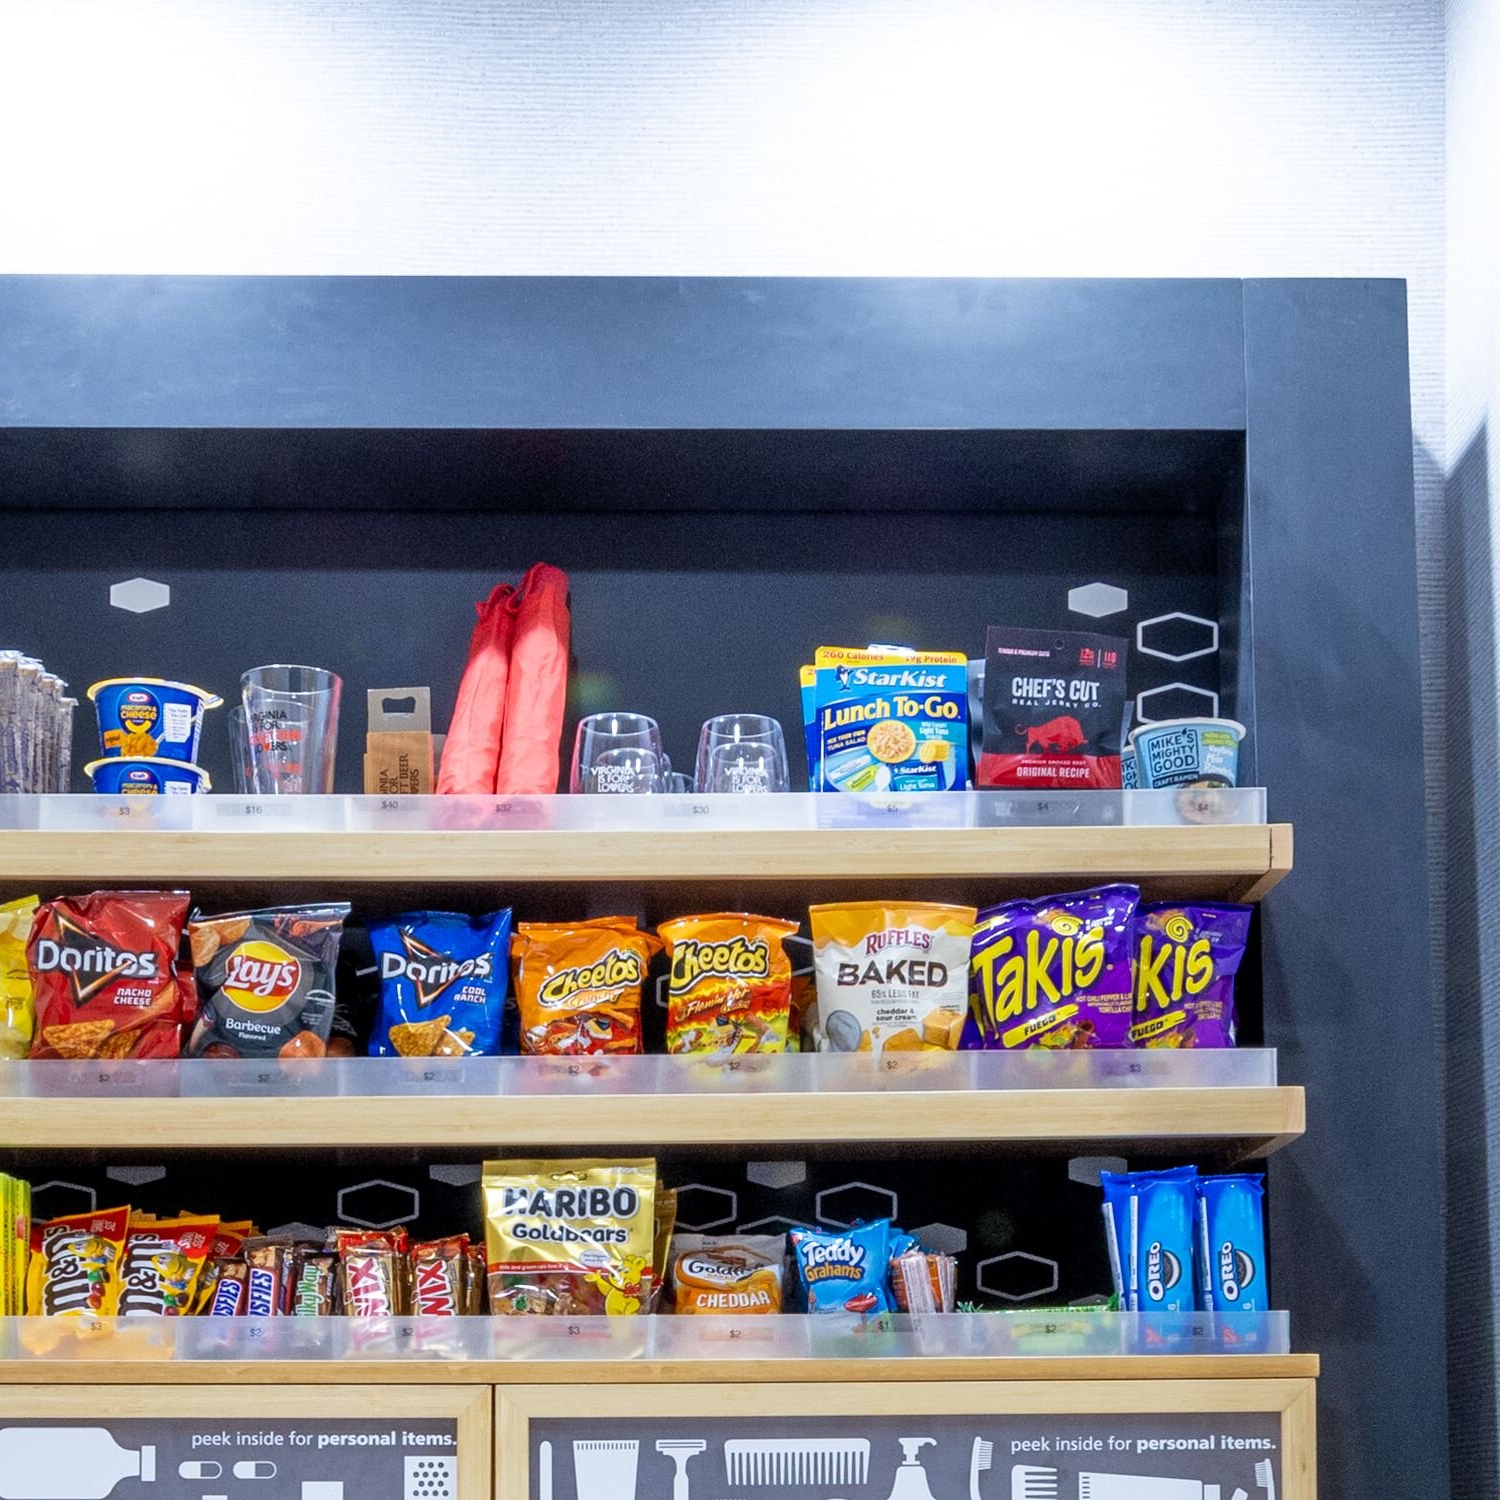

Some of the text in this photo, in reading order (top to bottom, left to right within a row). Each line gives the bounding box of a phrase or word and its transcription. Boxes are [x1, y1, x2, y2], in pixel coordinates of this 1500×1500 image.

[823, 651, 884, 660] 260 Calories
[924, 655, 957, 663] Protein
[853, 668, 947, 687] StarKist
[1012, 677, 1100, 701] CHEF'S CUT
[1045, 699, 1078, 708] JERKY
[824, 698, 890, 730] Lunch
[1150, 729, 1194, 752] MIKE'S
[1152, 744, 1195, 762] MIGHTY
[399, 753, 409, 780] BEER
[900, 765, 937, 774] StarKist
[1153, 755, 1196, 774] GOOD
[591, 766, 635, 776] VIRGINIA
[1016, 767, 1090, 778] ORIGINAL RECIPE
[598, 774, 627, 783] IS FOR
[118, 805, 131, 816] $3
[244, 804, 263, 814] $16
[382, 801, 399, 810] $40
[494, 803, 512, 814] $32
[865, 930, 931, 956] RUFFLES
[38, 941, 155, 977] Doritos
[670, 939, 767, 990] Cheetos
[381, 952, 493, 981] Doritos
[226, 955, 297, 998] Lay's
[541, 954, 639, 1004] Cheetos
[837, 960, 948, 987] BAKED
[116, 987, 152, 997] NACHO
[461, 986, 487, 995] COOL
[114, 996, 152, 1007] CHEESE
[453, 994, 487, 1004] RANCH
[226, 1018, 282, 1035] Barbecue
[1024, 1014, 1057, 1037] FUEGO
[1132, 1020, 1164, 1038] FUEGO
[568, 1064, 580, 1074] $2
[730, 1061, 740, 1071] $2
[886, 1060, 898, 1070] $2
[1130, 1064, 1142, 1074] $3
[100, 1074, 110, 1083] $2
[258, 1074, 270, 1083] $2
[423, 1072, 435, 1082] $2
[504, 1186, 638, 1218] HARIBO
[512, 1223, 627, 1243] Goldbears
[802, 1238, 865, 1266] Teddy
[805, 1262, 863, 1281] Grahams
[1148, 1241, 1162, 1301] OREO
[1221, 1241, 1239, 1301] OREO
[696, 1291, 771, 1308] CHEDDAR
[90, 1322, 102, 1331] $3
[568, 1326, 580, 1335] $3
[878, 1320, 890, 1330] $1
[1044, 1324, 1058, 1334] $2
[402, 1328, 414, 1336] $2
[730, 1330, 742, 1338] $2
[191, 1431, 457, 1449] peek inside for personal items.
[1011, 1435, 1276, 1455] peek inside for personal items.
